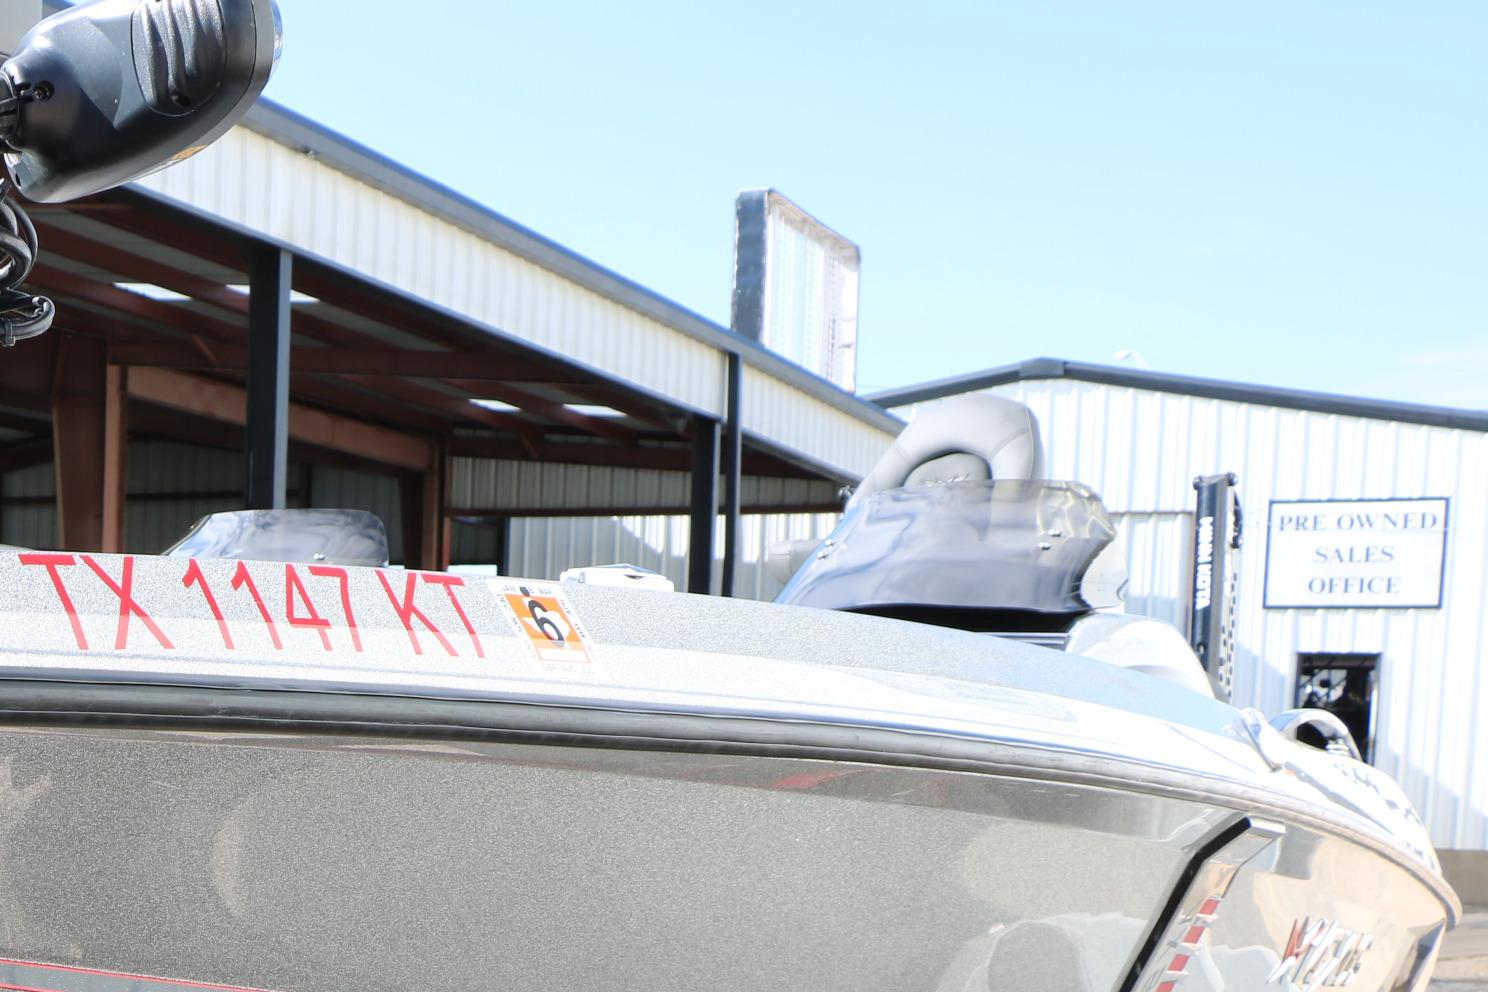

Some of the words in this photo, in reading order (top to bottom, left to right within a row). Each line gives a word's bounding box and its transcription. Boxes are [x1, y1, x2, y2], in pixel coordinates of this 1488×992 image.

[1279, 515, 1326, 531] PRE
[1337, 512, 1437, 530] OWNED
[1314, 546, 1394, 563] SALES
[1195, 563, 1212, 610] KOTA
[1308, 577, 1401, 594] OFFICE
[18, 554, 175, 650] TX
[182, 558, 364, 652] 1147
[375, 569, 486, 658] KT
[528, 600, 565, 647] 6
